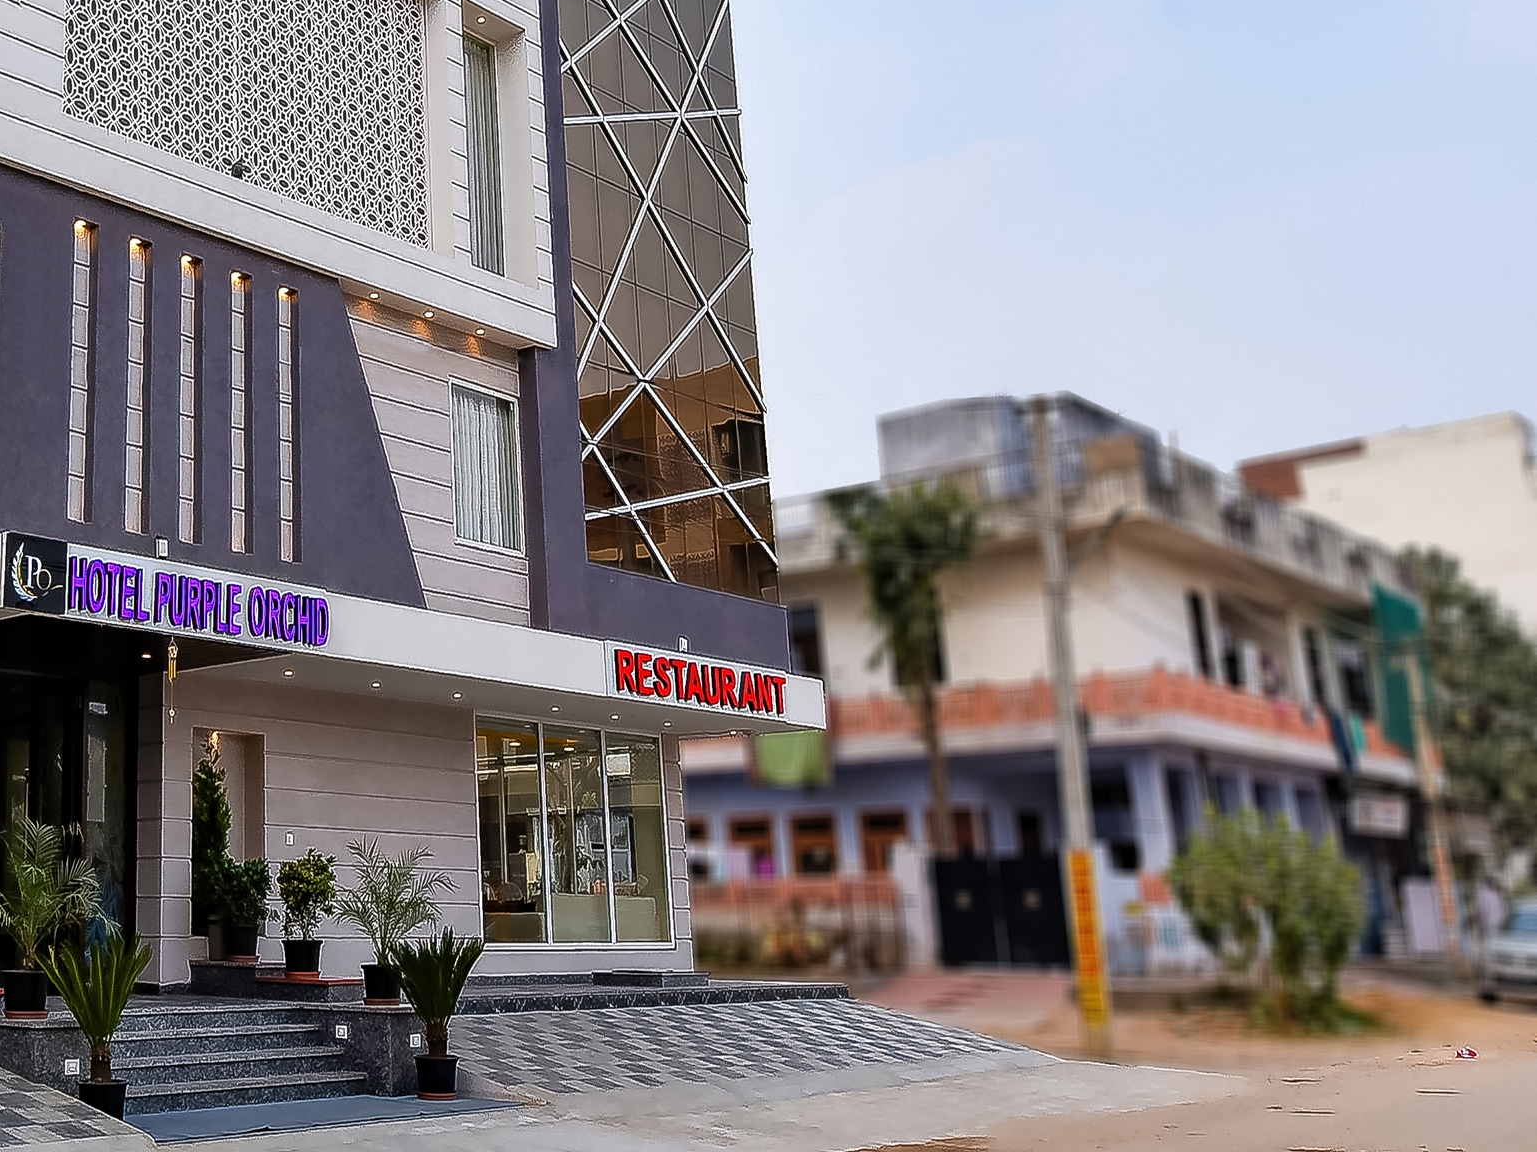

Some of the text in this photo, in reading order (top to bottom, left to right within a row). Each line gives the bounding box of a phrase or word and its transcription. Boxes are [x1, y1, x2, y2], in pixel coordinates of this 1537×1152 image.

[69, 557, 330, 646] HOTEL PURPLE ORCHID
[613, 649, 786, 715] RESTAURANT
